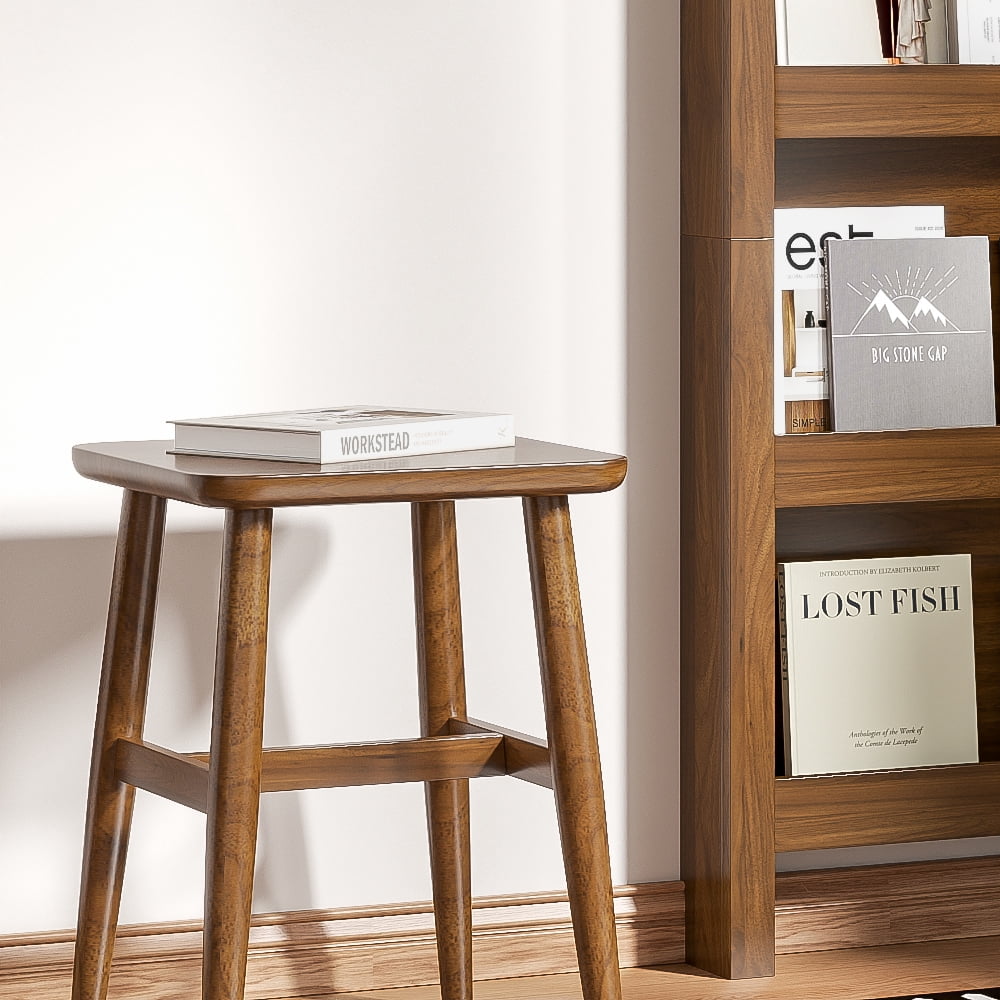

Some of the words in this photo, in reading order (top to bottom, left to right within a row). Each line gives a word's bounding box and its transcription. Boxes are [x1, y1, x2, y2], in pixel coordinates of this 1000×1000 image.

[871, 347, 890, 364] BIG
[893, 346, 924, 363] STONE
[927, 345, 948, 362] GAP
[341, 431, 410, 456] WORKSTEAD
[819, 568, 869, 577] INTRODUCTION
[869, 567, 878, 575] BY
[878, 566, 912, 575] ELIZABETH
[912, 565, 940, 573] KOLBERT
[800, 590, 883, 619] LOST
[890, 585, 962, 615] FISH
[900, 726, 916, 735] Work
[916, 725, 924, 735] of
[854, 739, 864, 748] the
